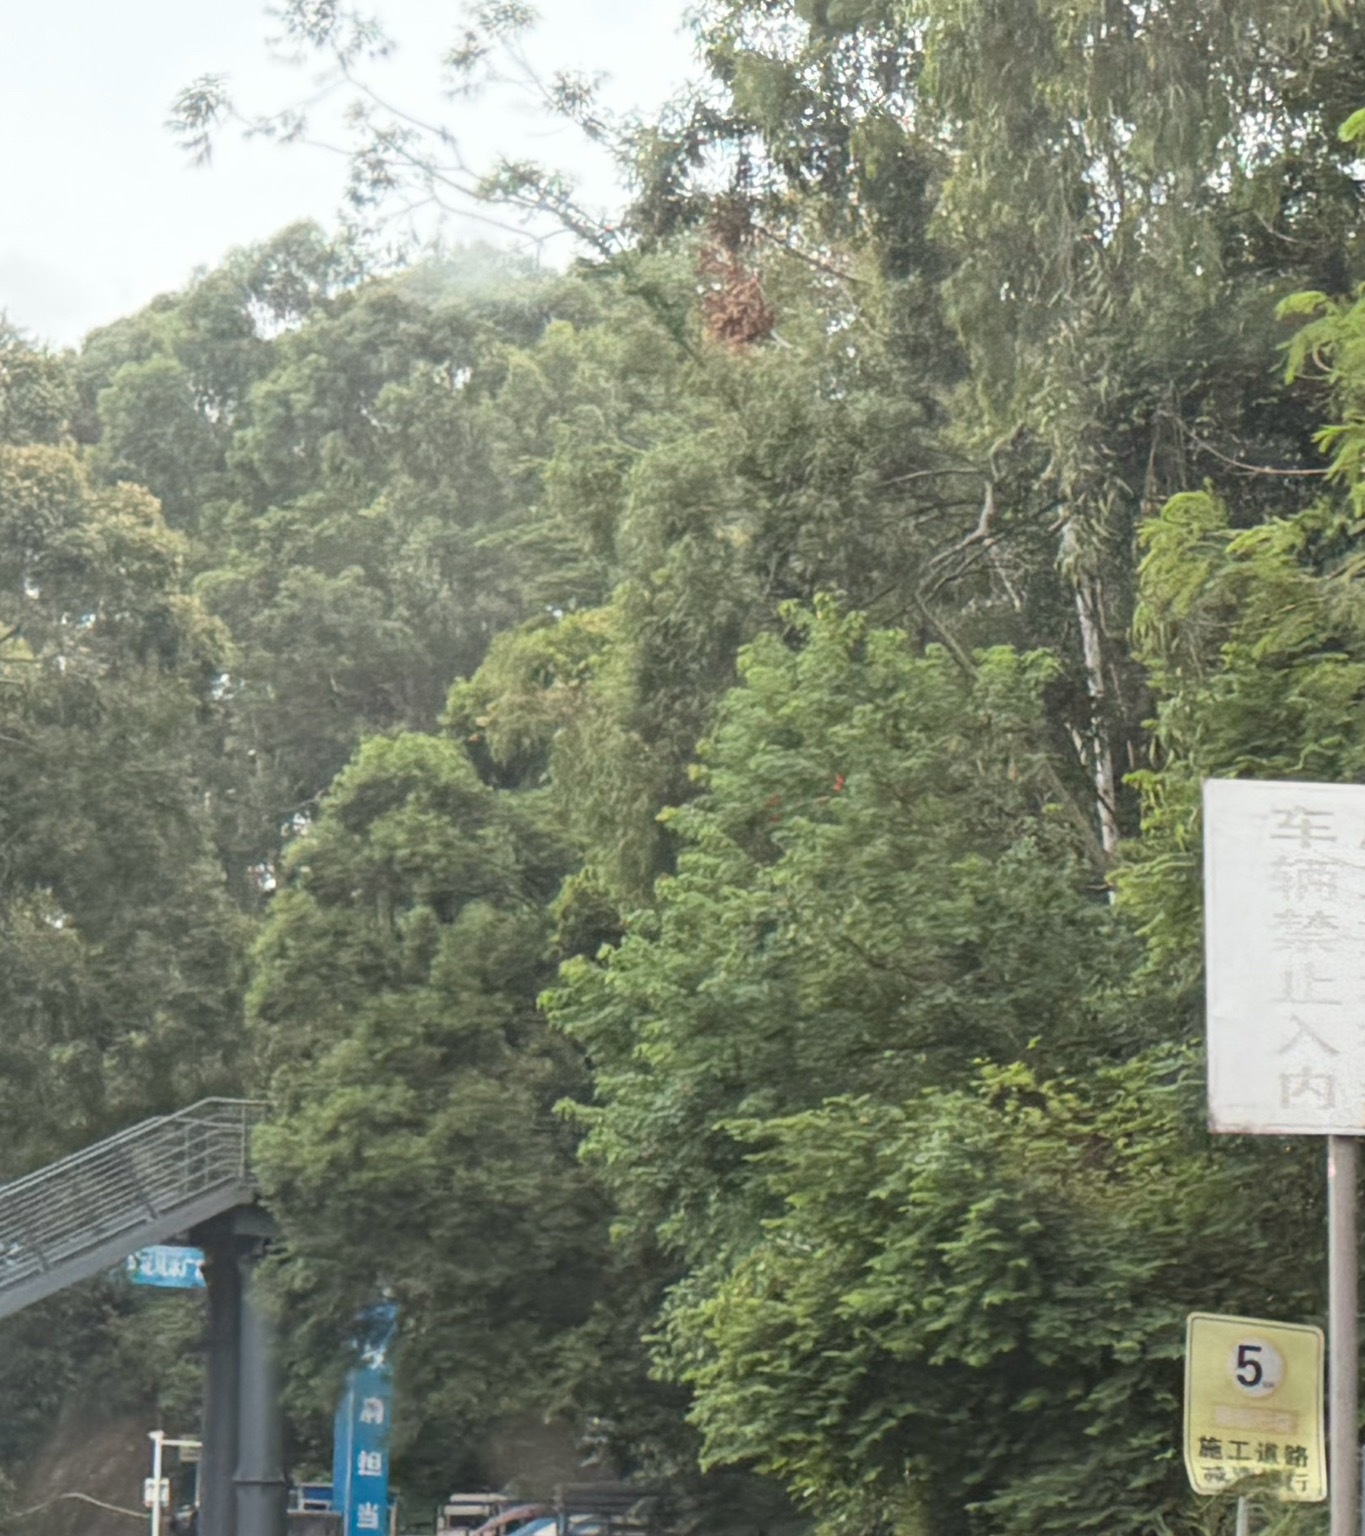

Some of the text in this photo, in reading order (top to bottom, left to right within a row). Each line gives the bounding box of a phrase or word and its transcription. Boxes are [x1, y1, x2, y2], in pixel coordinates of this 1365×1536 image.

[1269, 804, 1344, 1111] 车辆禁止入内
[1236, 1344, 1263, 1388] 5
